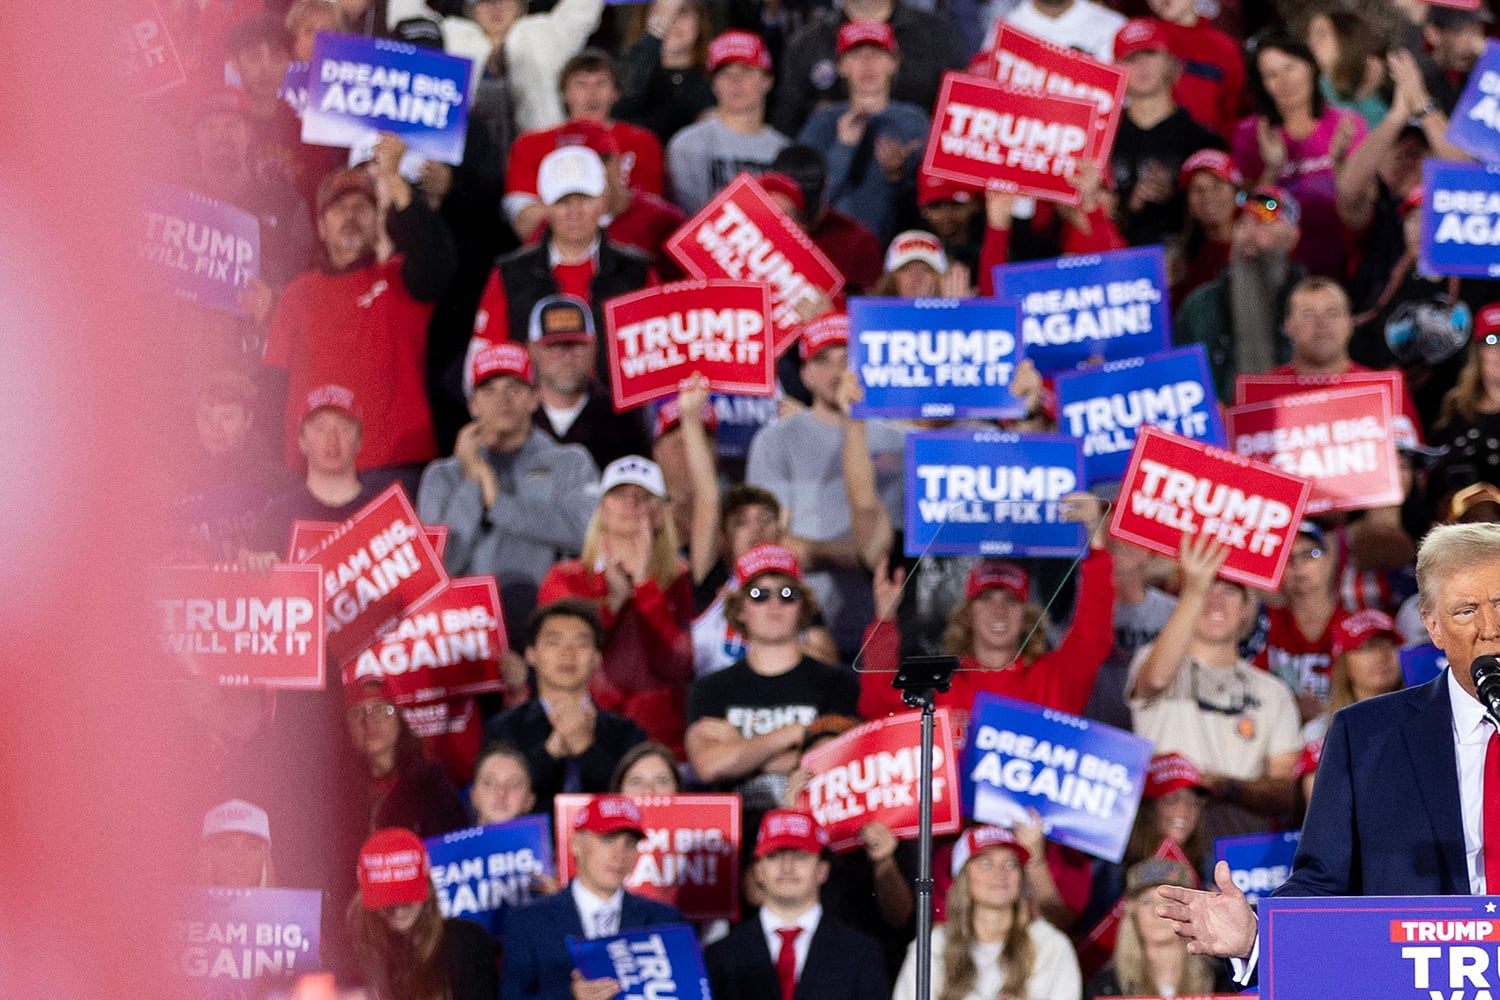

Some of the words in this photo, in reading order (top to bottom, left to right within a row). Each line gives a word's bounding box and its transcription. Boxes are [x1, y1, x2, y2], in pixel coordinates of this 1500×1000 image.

[321, 59, 409, 92] DREAM
[411, 74, 462, 105] BIG,
[320, 81, 449, 128] AGAIN!
[946, 103, 1086, 155] TRUMP
[942, 133, 1003, 163] WILL
[1005, 147, 1048, 172] FIX
[1050, 154, 1076, 176] IT
[1022, 284, 1106, 315] REAM
[1107, 278, 1161, 306] BIG,
[617, 309, 763, 355] TRUMP
[1021, 303, 1152, 344] AGAIN!
[621, 348, 686, 378] WILL
[688, 341, 735, 364] FIX
[737, 340, 762, 364] IT
[860, 330, 1015, 366] TRUMP
[861, 363, 930, 387] WILL
[934, 362, 982, 386] FIX
[982, 362, 1012, 386] IT
[1064, 381, 1205, 438] TRUMP
[1237, 421, 1330, 455] DREAM
[1332, 415, 1387, 442] BIG,
[1272, 441, 1378, 478] GAIN!
[917, 465, 1077, 501] TRUMP
[1141, 460, 1291, 530] TRUMP
[920, 502, 988, 523] WILL
[995, 501, 1038, 523] FIX
[1132, 490, 1197, 535] WILL
[1201, 517, 1251, 548] FIX
[1252, 527, 1282, 558] IT
[324, 549, 372, 597] EAM
[370, 519, 418, 554] BIG,
[160, 597, 314, 632] TRUMP
[442, 606, 498, 631] BIG,
[234, 632, 278, 656] FIX
[285, 632, 312, 656] IT
[355, 629, 488, 676] AGAIN!
[976, 724, 1077, 770] DREAM
[1078, 752, 1133, 794] BIG,
[866, 783, 913, 811] FIX
[971, 750, 1119, 820] AGAIN!
[676, 829, 730, 855] BIG,
[430, 858, 484, 887] EAM
[487, 848, 542, 875] BIG,
[625, 854, 718, 888] AIN!
[256, 922, 310, 953] BIG,
[1401, 920, 1494, 941] TRUMP
[184, 944, 297, 980] GAIN!
